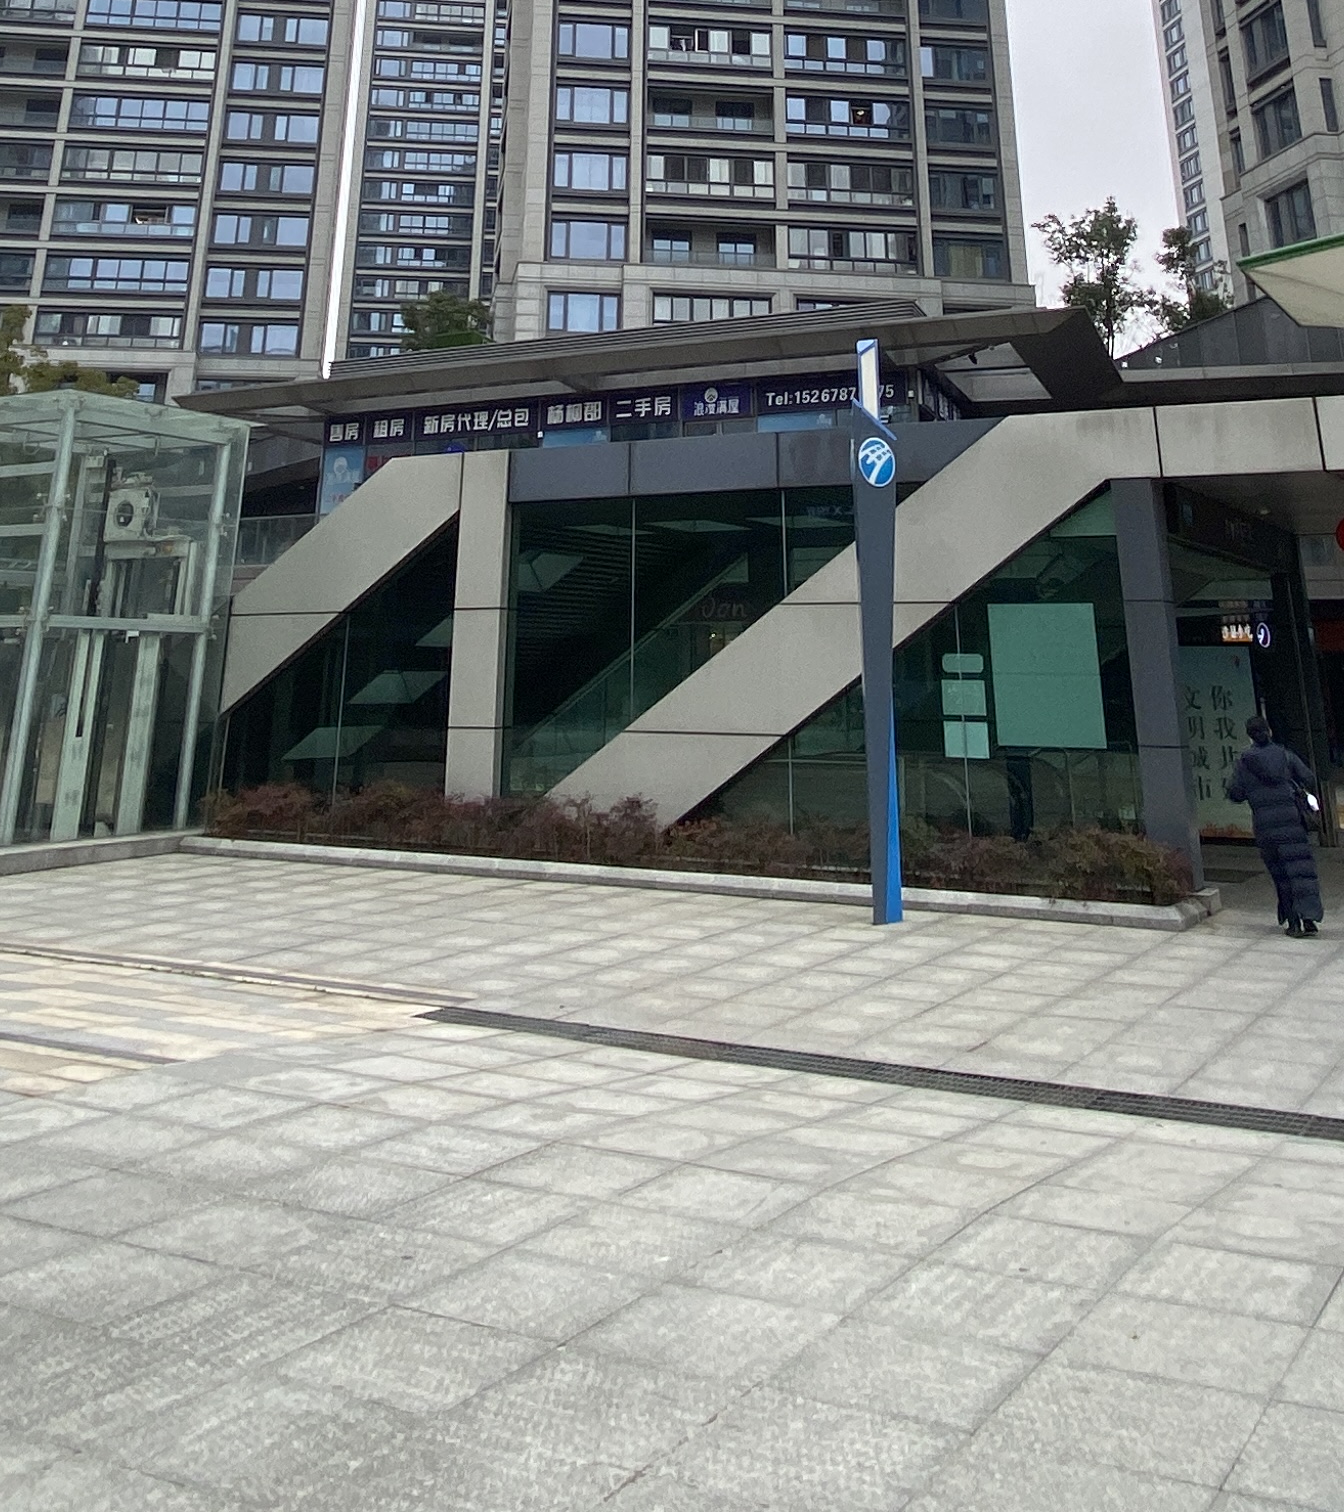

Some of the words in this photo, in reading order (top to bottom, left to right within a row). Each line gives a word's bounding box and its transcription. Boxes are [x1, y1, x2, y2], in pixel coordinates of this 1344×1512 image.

[329, 422, 360, 442] 售房
[373, 418, 405, 439] 租房
[423, 407, 529, 435] 新房代理/总包
[615, 396, 672, 419] 二手房
[766, 384, 895, 406] Tel:152678775
